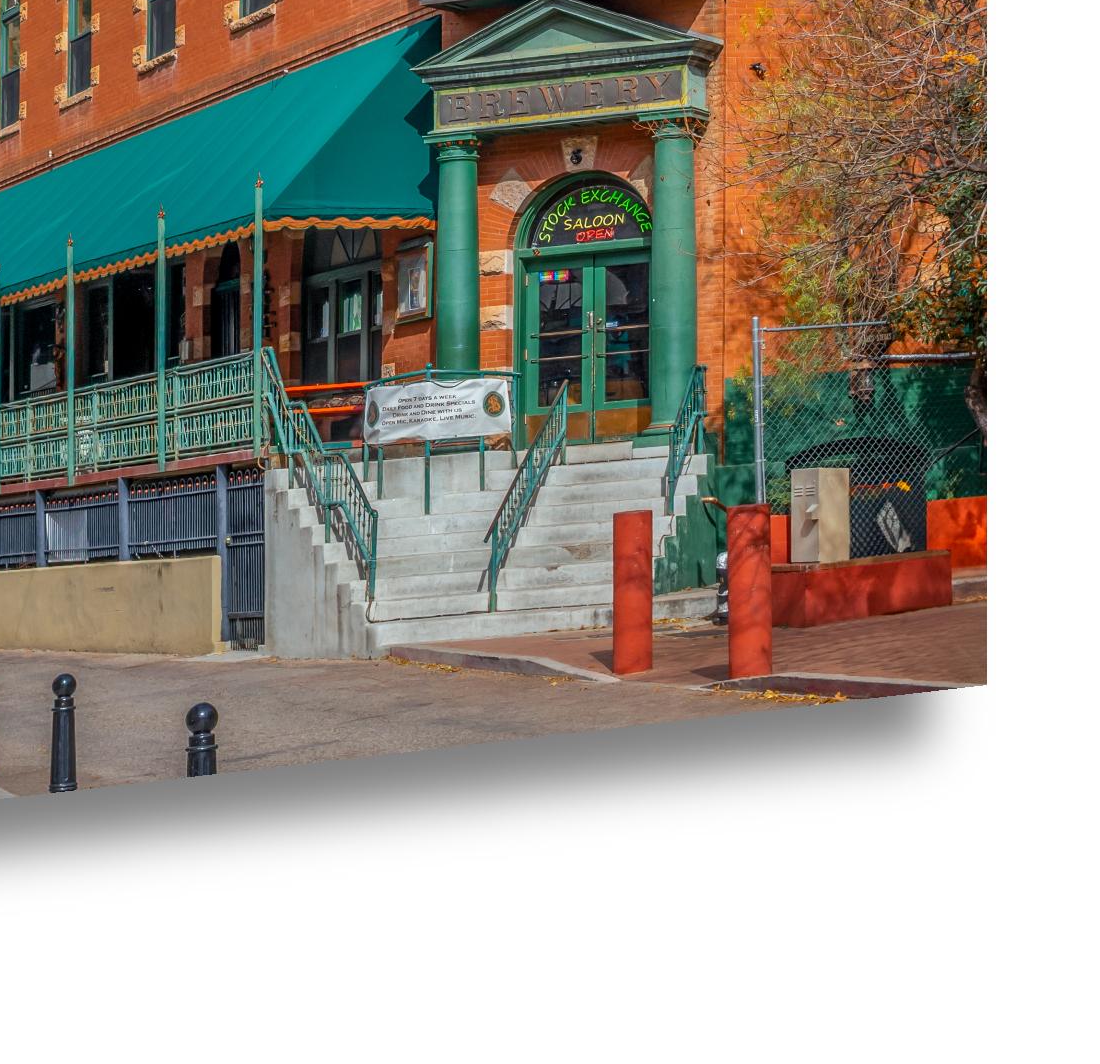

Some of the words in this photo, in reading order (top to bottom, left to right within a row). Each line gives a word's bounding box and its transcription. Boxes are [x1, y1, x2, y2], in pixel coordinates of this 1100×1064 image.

[447, 72, 673, 123] BREWERY
[538, 194, 577, 243] STOCK
[581, 189, 653, 233] EXCHANGE
[564, 213, 625, 231] SALOON
[575, 227, 615, 242] OPEN
